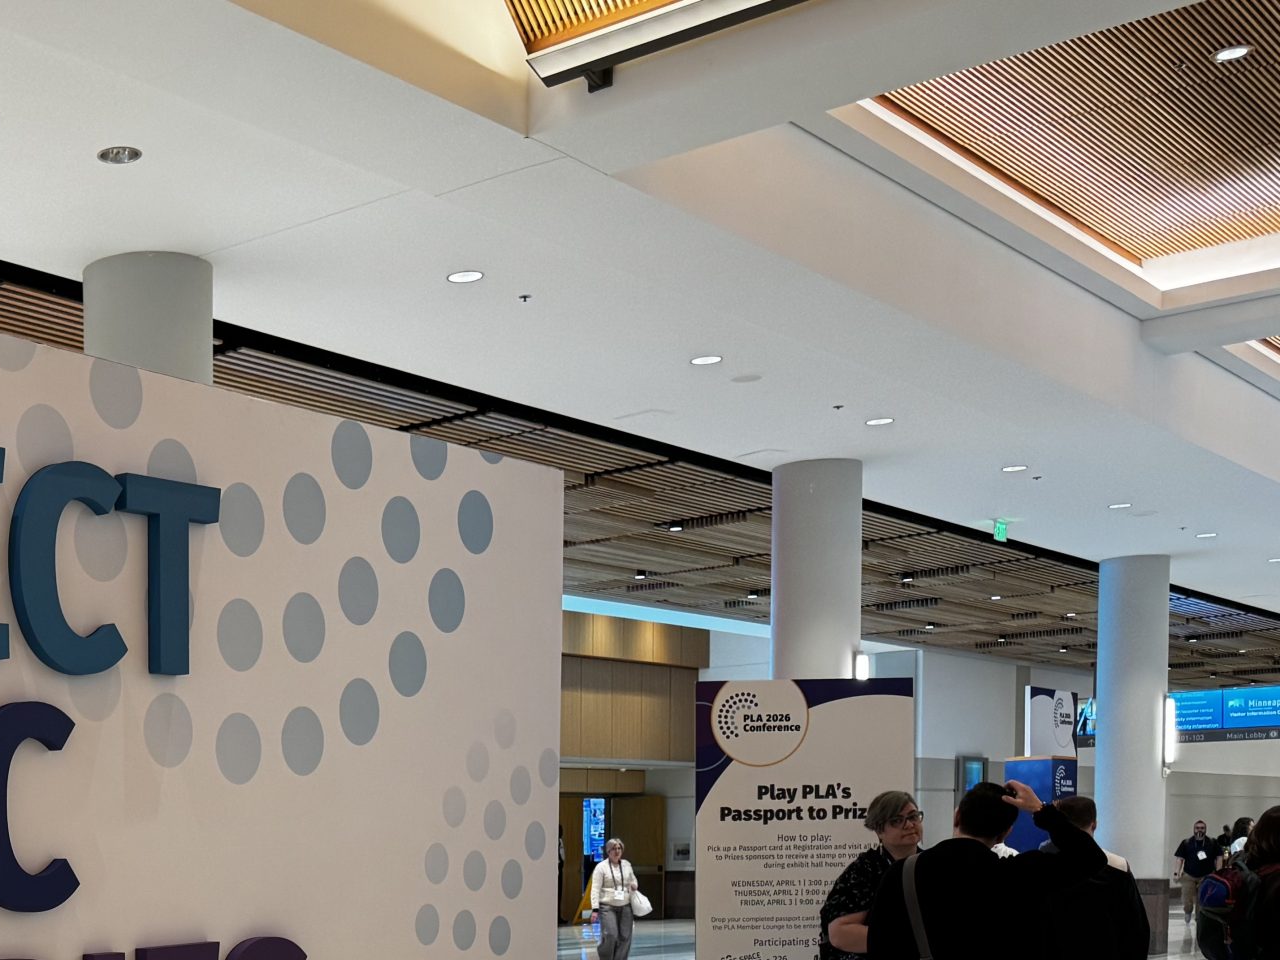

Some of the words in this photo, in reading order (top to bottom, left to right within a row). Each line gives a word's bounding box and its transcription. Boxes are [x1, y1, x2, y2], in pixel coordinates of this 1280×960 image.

[1248, 699, 1280, 708] Minneap
[743, 714, 763, 723] PLA
[765, 713, 791, 722] 2026
[743, 723, 801, 732] Conference
[1245, 731, 1267, 740] Lobby
[757, 784, 798, 804] Play
[802, 783, 852, 800] PLA's
[720, 805, 804, 825] Passport
[807, 806, 827, 820] to
[832, 802, 867, 820] Priz
[777, 834, 797, 842] How
[799, 834, 808, 842] to
[810, 833, 832, 844] play:
[739, 844, 767, 852] Passport
[793, 843, 833, 851] Registration
[724, 853, 744, 861] Prizes
[763, 862, 785, 870] during
[731, 879, 775, 888] WEDNESDAY,
[776, 879, 796, 887] APRIL
[734, 889, 772, 897] THURSDAY,
[740, 899, 766, 907] FRIDAY,
[711, 916, 726, 924] Drop
[727, 917, 741, 925] your
[775, 915, 801, 923] passport
[762, 923, 785, 931] Lounge
[753, 938, 810, 948] Participating
